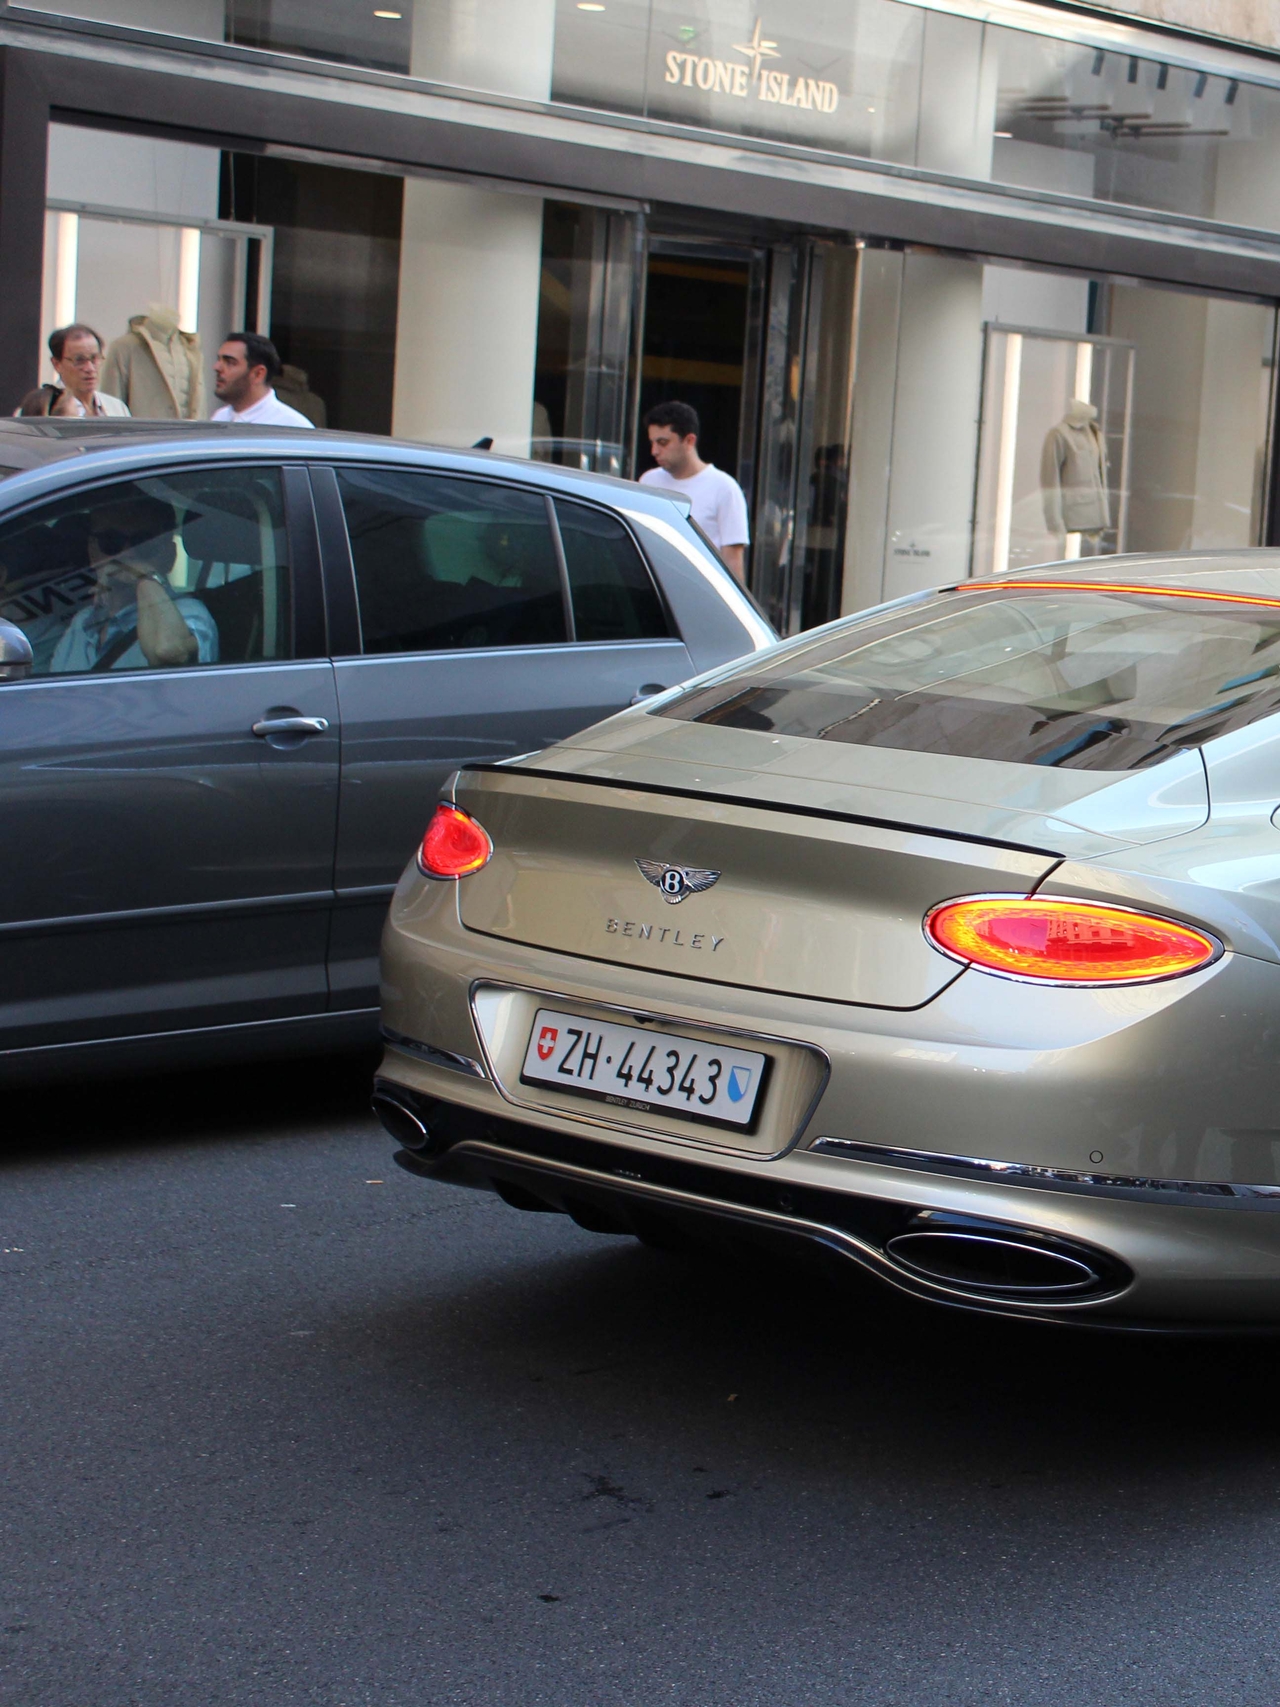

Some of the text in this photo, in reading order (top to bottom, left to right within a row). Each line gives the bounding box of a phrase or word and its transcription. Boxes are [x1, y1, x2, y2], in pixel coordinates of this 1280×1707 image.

[665, 51, 839, 113] STONE ISLAND
[605, 918, 724, 952] BENTLEY
